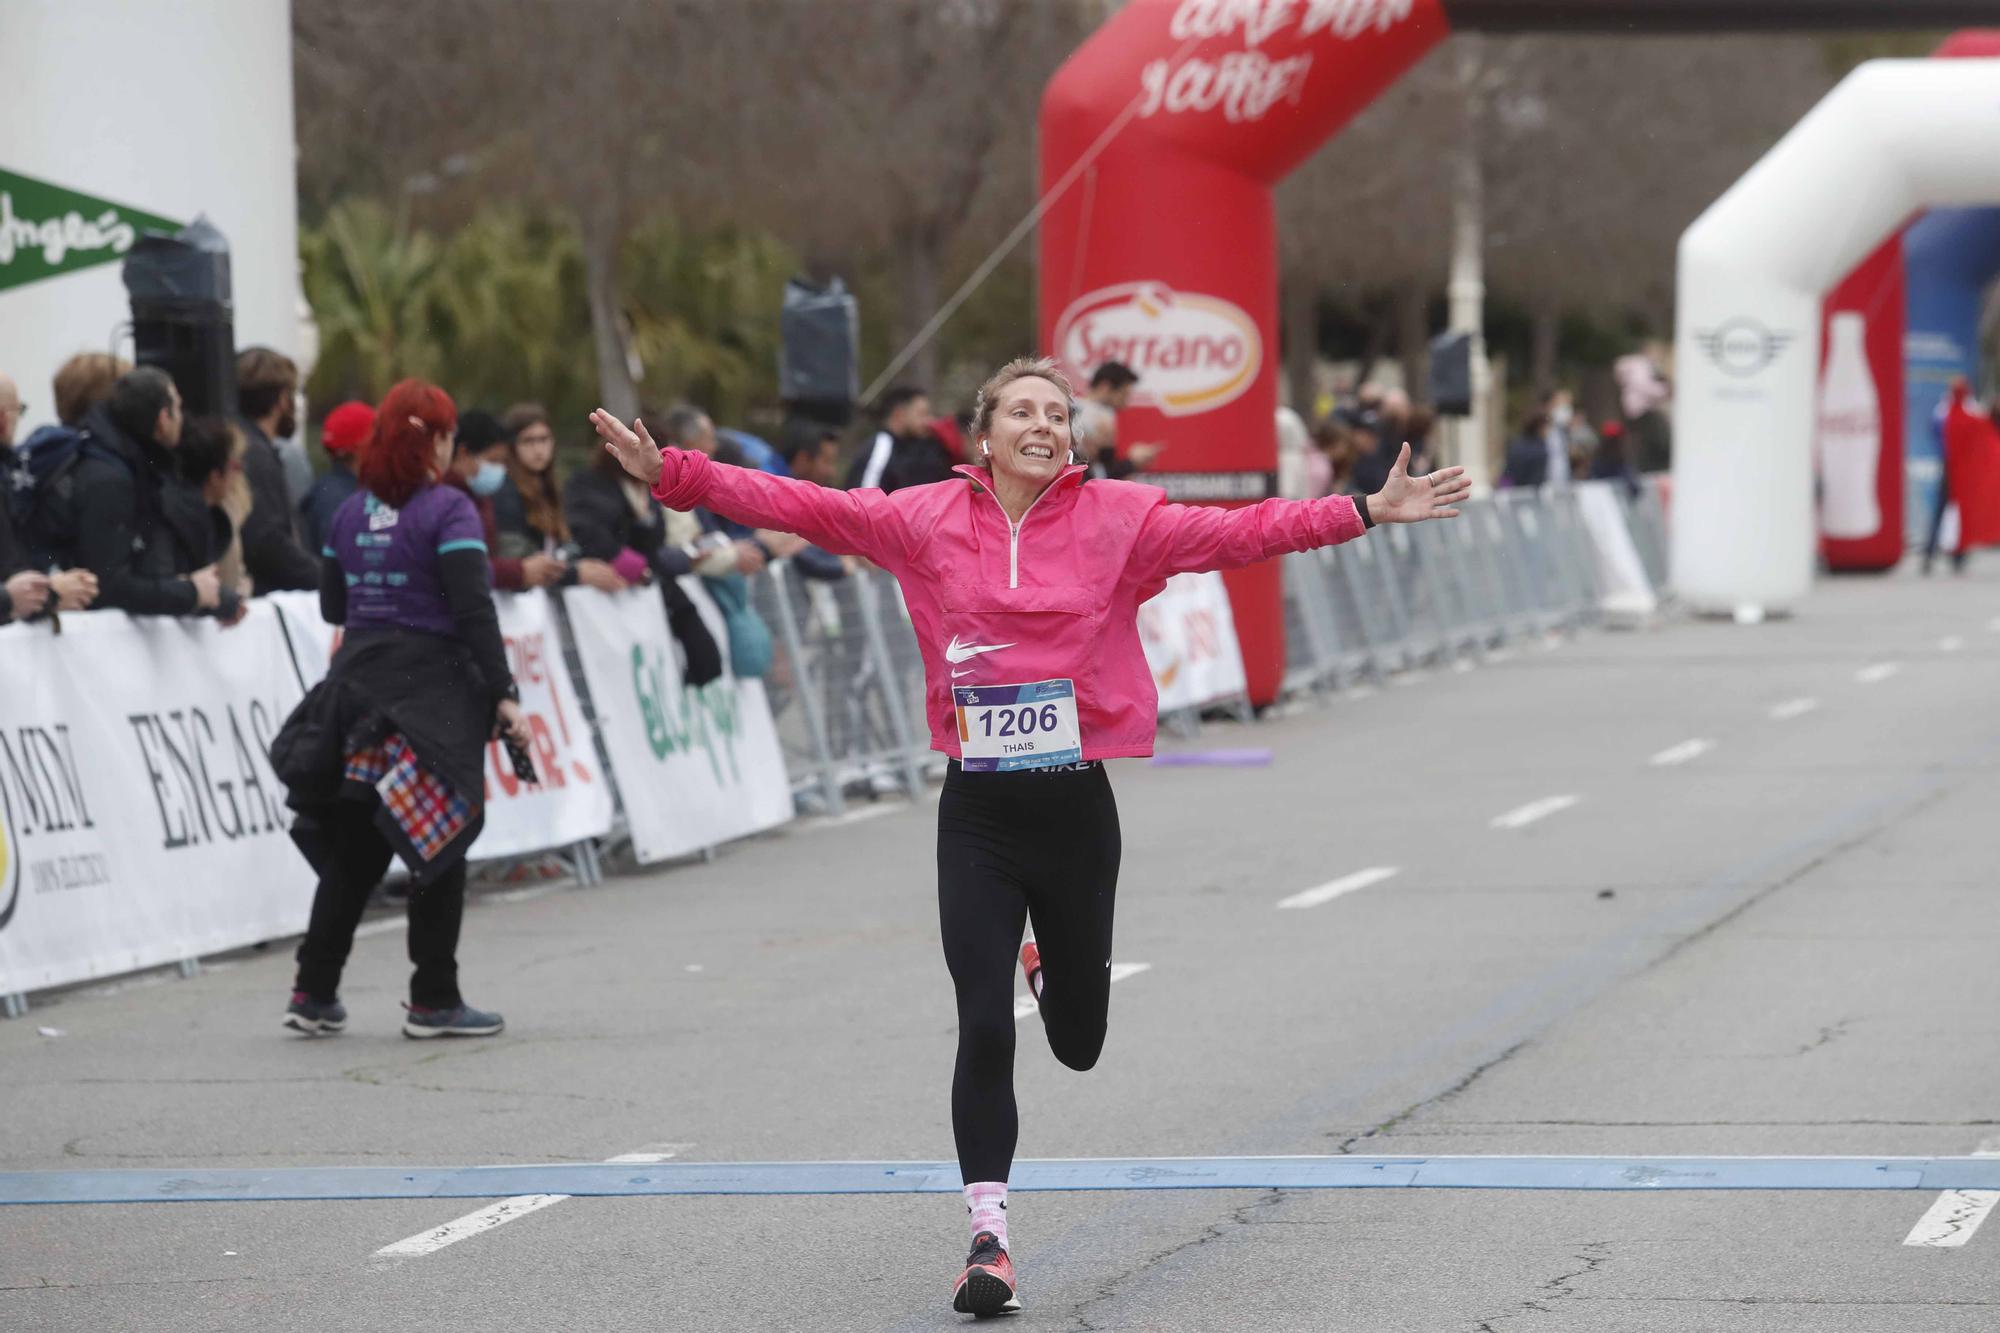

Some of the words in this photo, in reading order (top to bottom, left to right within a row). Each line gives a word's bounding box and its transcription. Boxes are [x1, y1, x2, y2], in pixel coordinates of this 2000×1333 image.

[1080, 317, 1243, 371] Serrano
[979, 704, 1058, 737] 1206
[1003, 742, 1035, 754] THAIS
